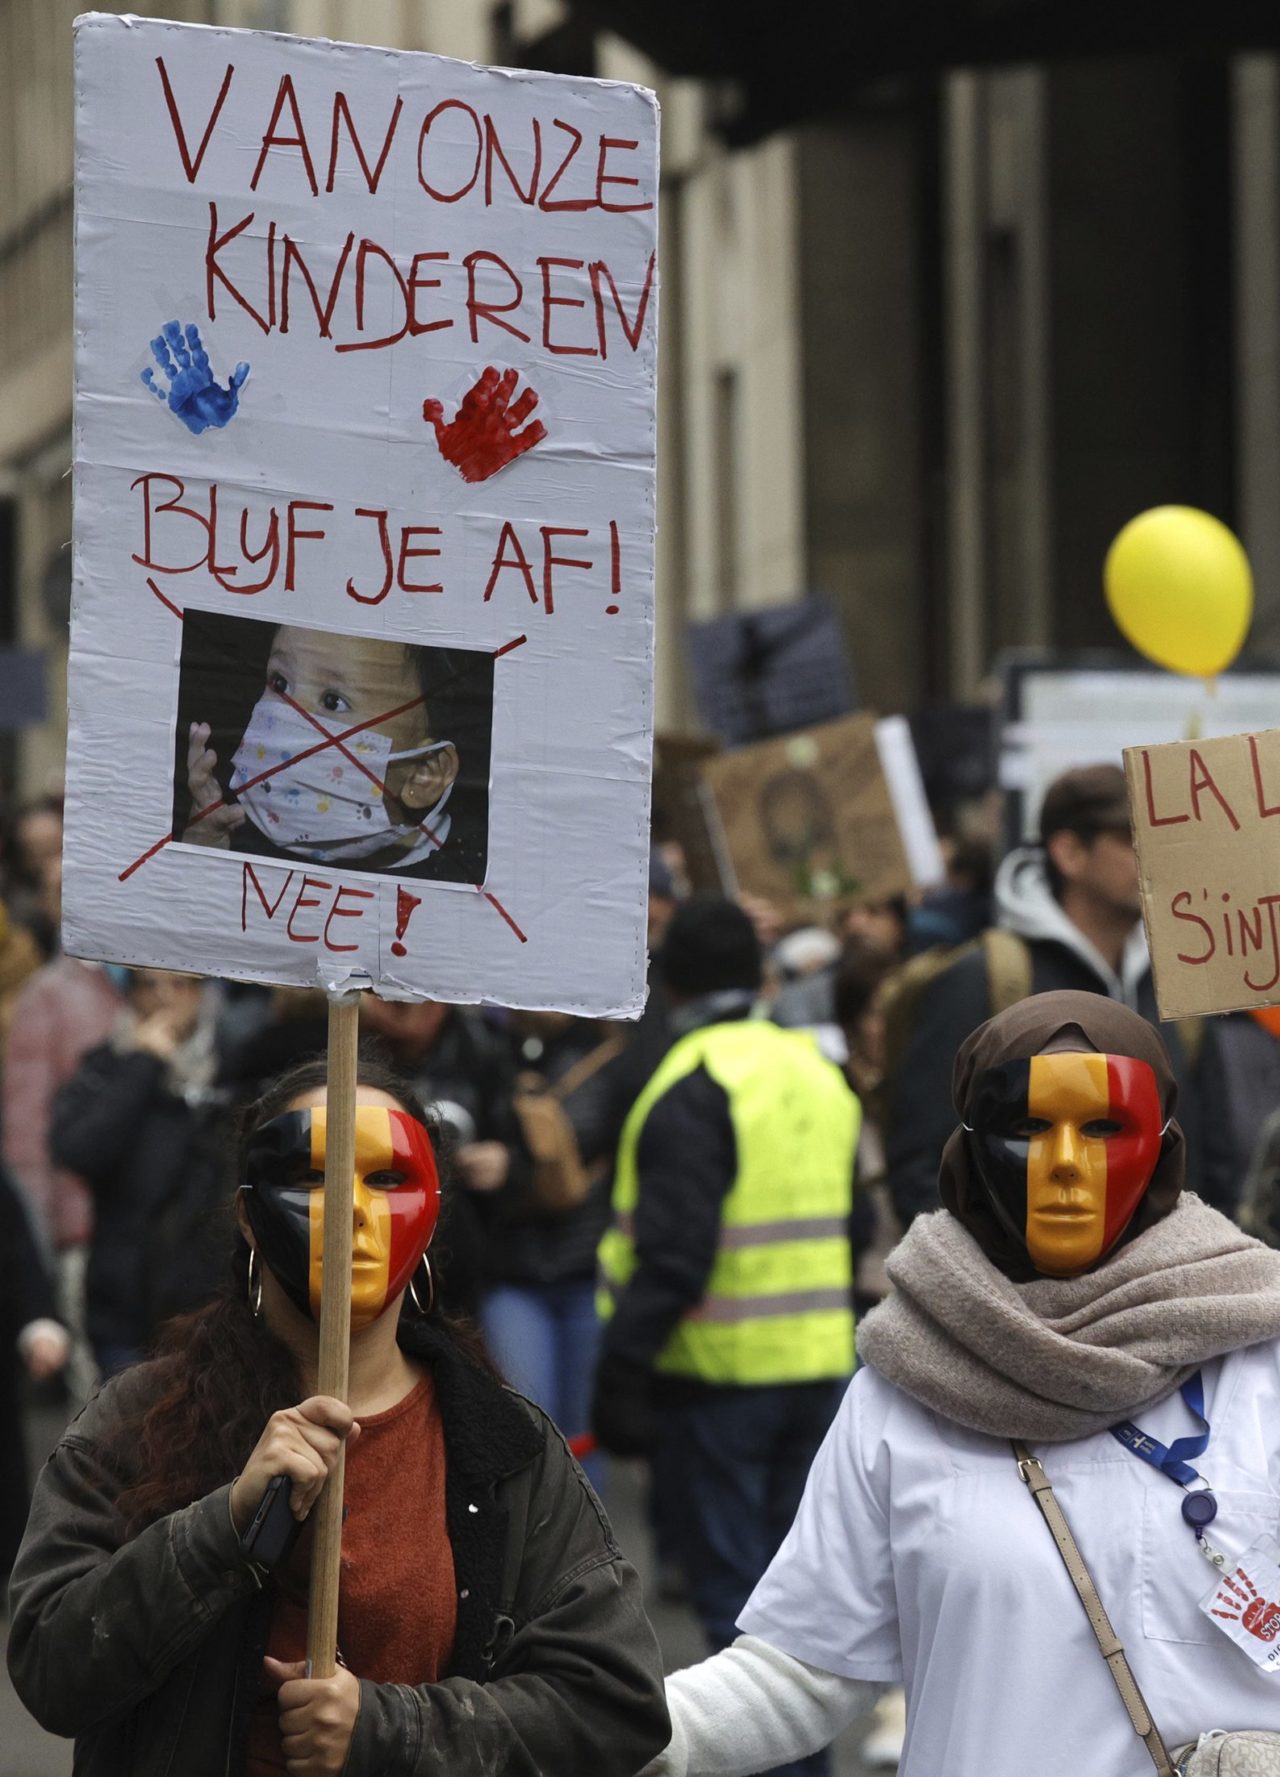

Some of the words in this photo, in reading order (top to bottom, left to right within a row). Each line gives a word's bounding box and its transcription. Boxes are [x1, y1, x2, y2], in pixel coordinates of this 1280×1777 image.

[156, 56, 403, 196] VAN
[417, 98, 654, 212] ONZE
[205, 201, 656, 360] KINDEREN
[346, 506, 443, 605] JE
[483, 519, 622, 614] AF!
[1141, 748, 1241, 831] LA
